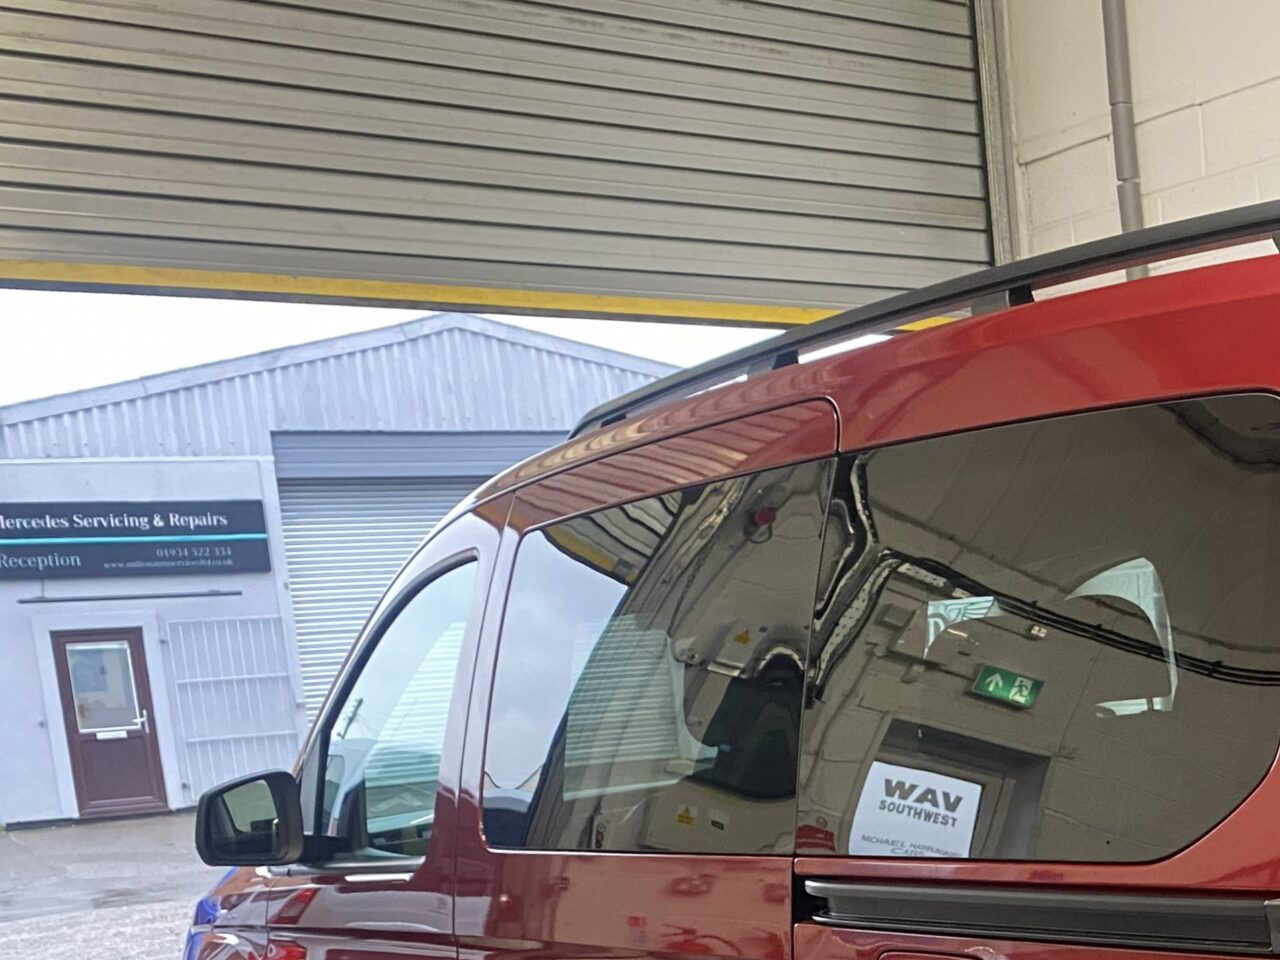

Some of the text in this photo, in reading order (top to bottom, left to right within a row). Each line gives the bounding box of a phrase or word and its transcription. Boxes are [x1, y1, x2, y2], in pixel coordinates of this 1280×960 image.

[73, 513, 150, 530] Servicing
[153, 512, 165, 527] &
[168, 511, 228, 531] Repairs
[0, 553, 81, 571] Reception
[884, 777, 963, 813] WAV
[879, 800, 957, 827] SOUTHWEST
